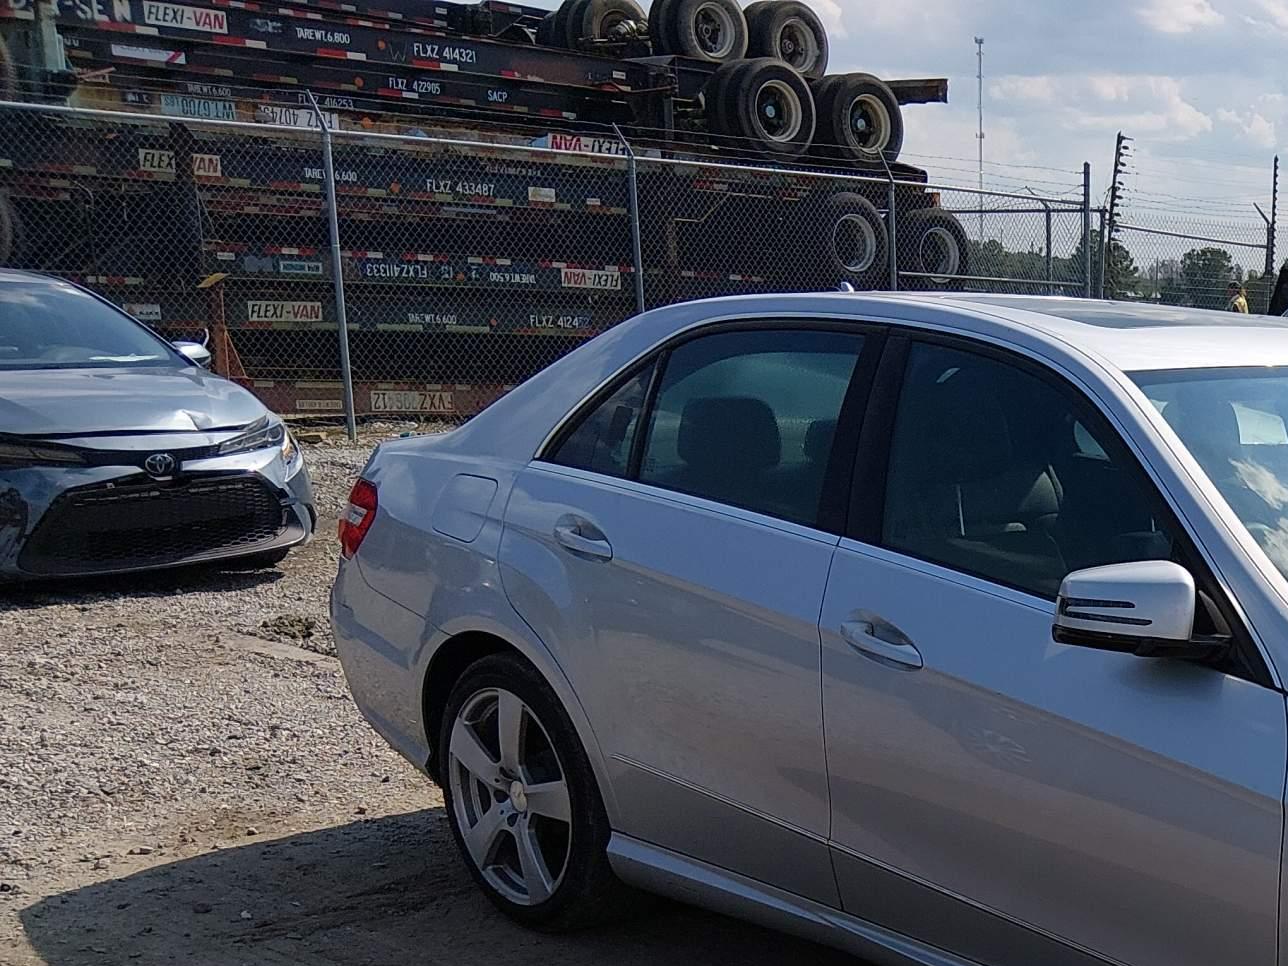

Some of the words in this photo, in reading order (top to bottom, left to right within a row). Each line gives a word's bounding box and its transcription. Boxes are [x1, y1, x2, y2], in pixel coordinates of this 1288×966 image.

[147, 5, 225, 31] FLEXI-VAN
[413, 42, 439, 59] FLXZ
[443, 45, 476, 63] 414321
[412, 80, 441, 94] 422905
[298, 93, 319, 106] FLZ
[324, 96, 354, 109] 416253
[426, 179, 451, 193] FLXZ
[455, 182, 495, 196] 433487
[563, 271, 619, 288] FLEXI-VAN
[250, 303, 320, 320] FLEXI-VAN
[529, 314, 554, 327] FLXZ
